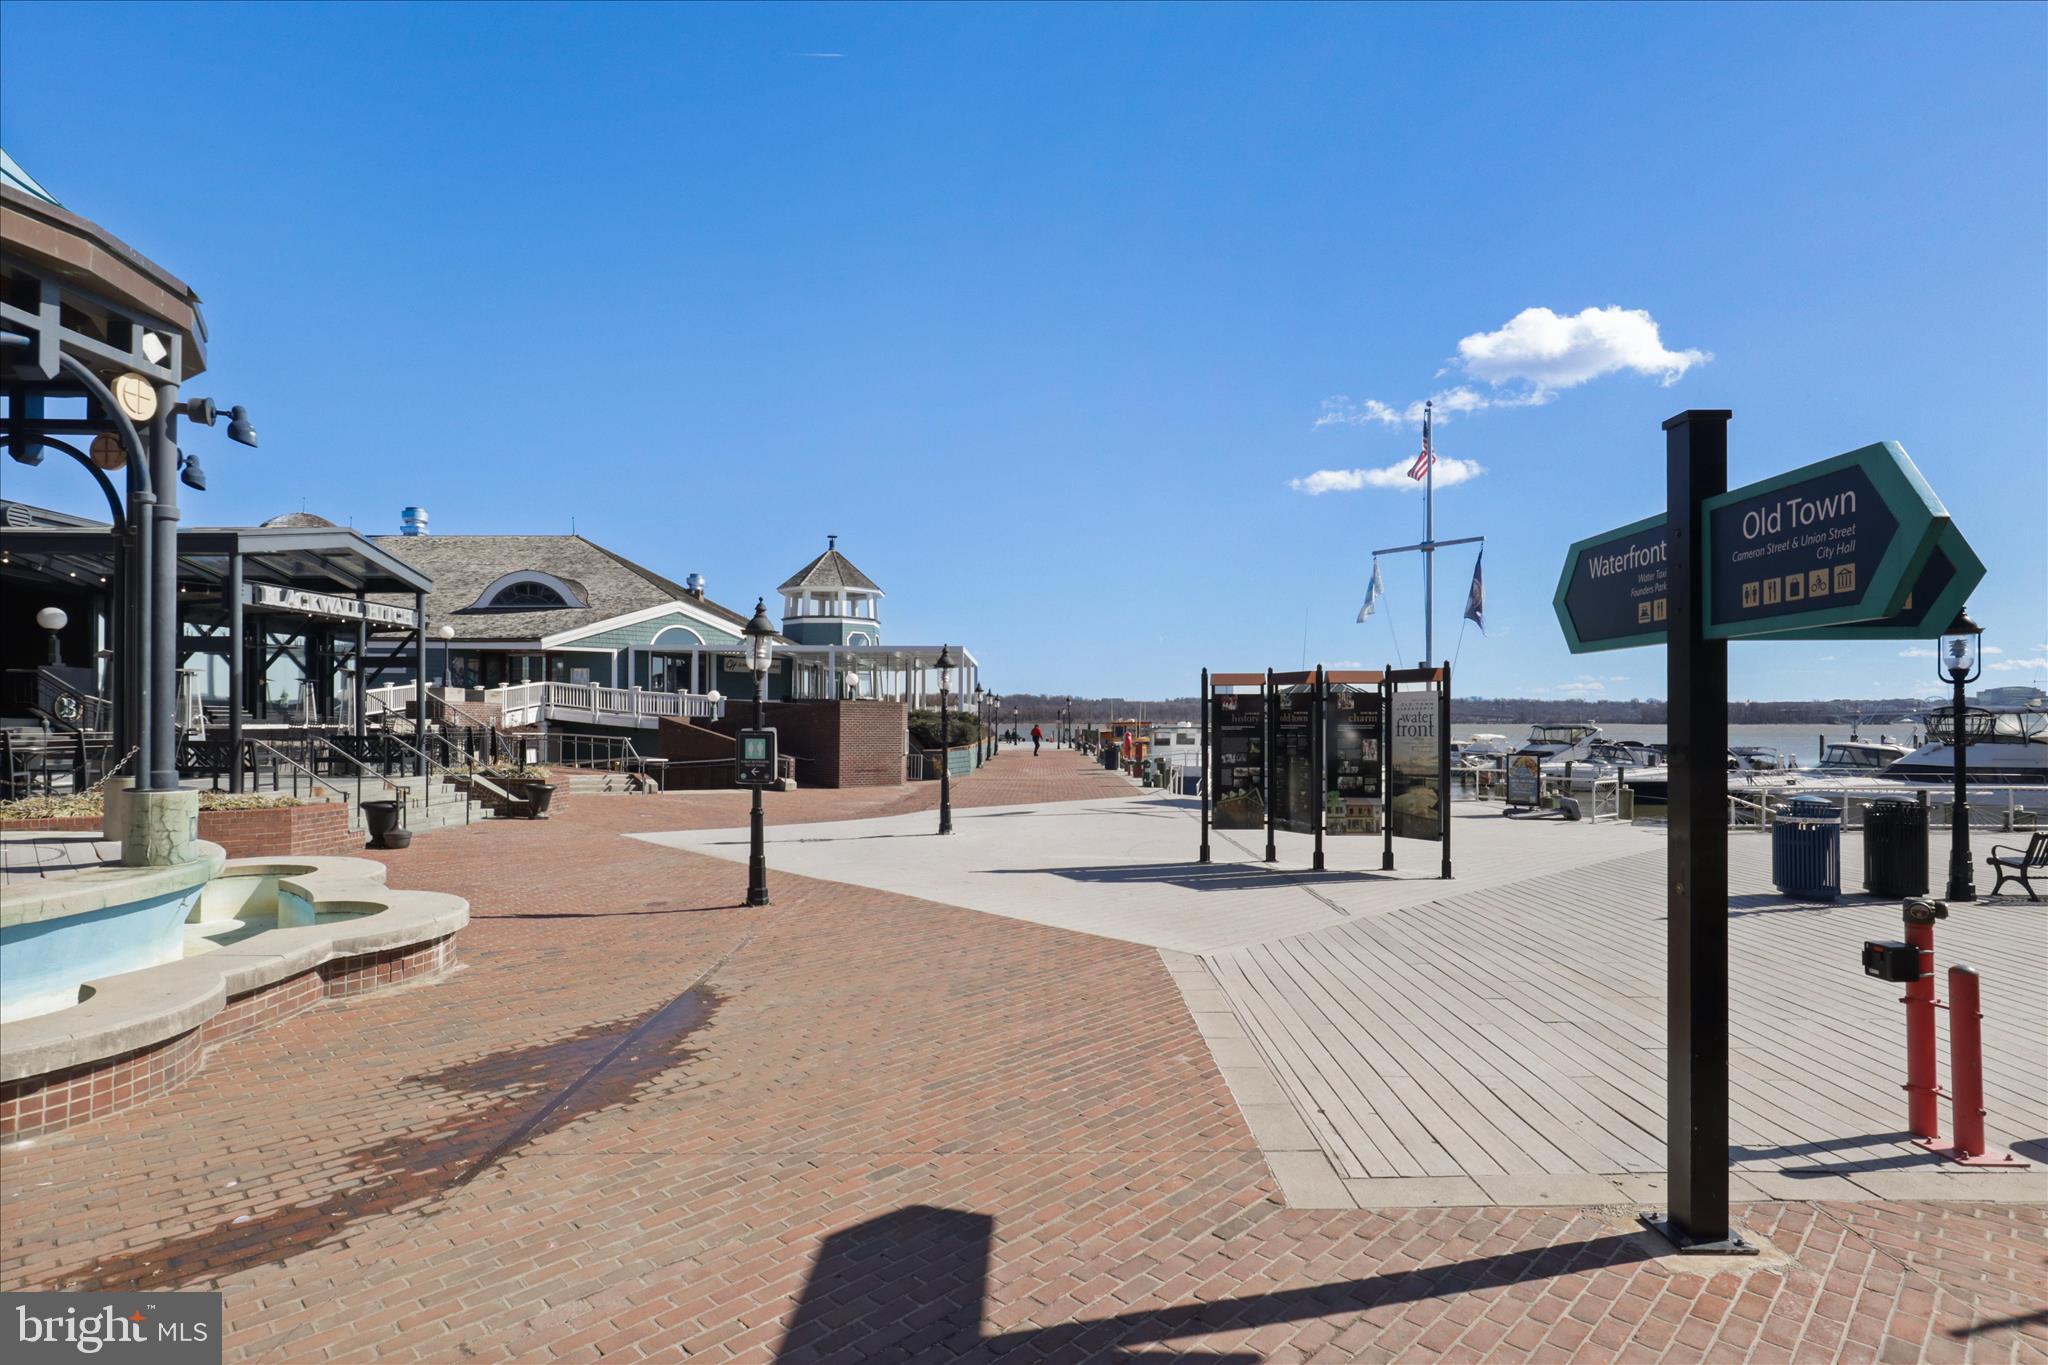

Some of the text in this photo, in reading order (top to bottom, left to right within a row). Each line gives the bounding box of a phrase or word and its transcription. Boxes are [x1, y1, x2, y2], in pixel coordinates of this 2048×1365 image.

[1742, 490, 1856, 540] Old Town
[1732, 523, 1856, 563] Cameron Street & Union Street
[1816, 540, 1856, 560] City Hall
[1589, 539, 1667, 579] Waterfront
[1638, 567, 1667, 583] Water Taxi
[1631, 581, 1667, 597] Founders Park
[1348, 712, 1377, 722] charm
[1395, 717, 1435, 737] front
[1401, 711, 1434, 723] water
